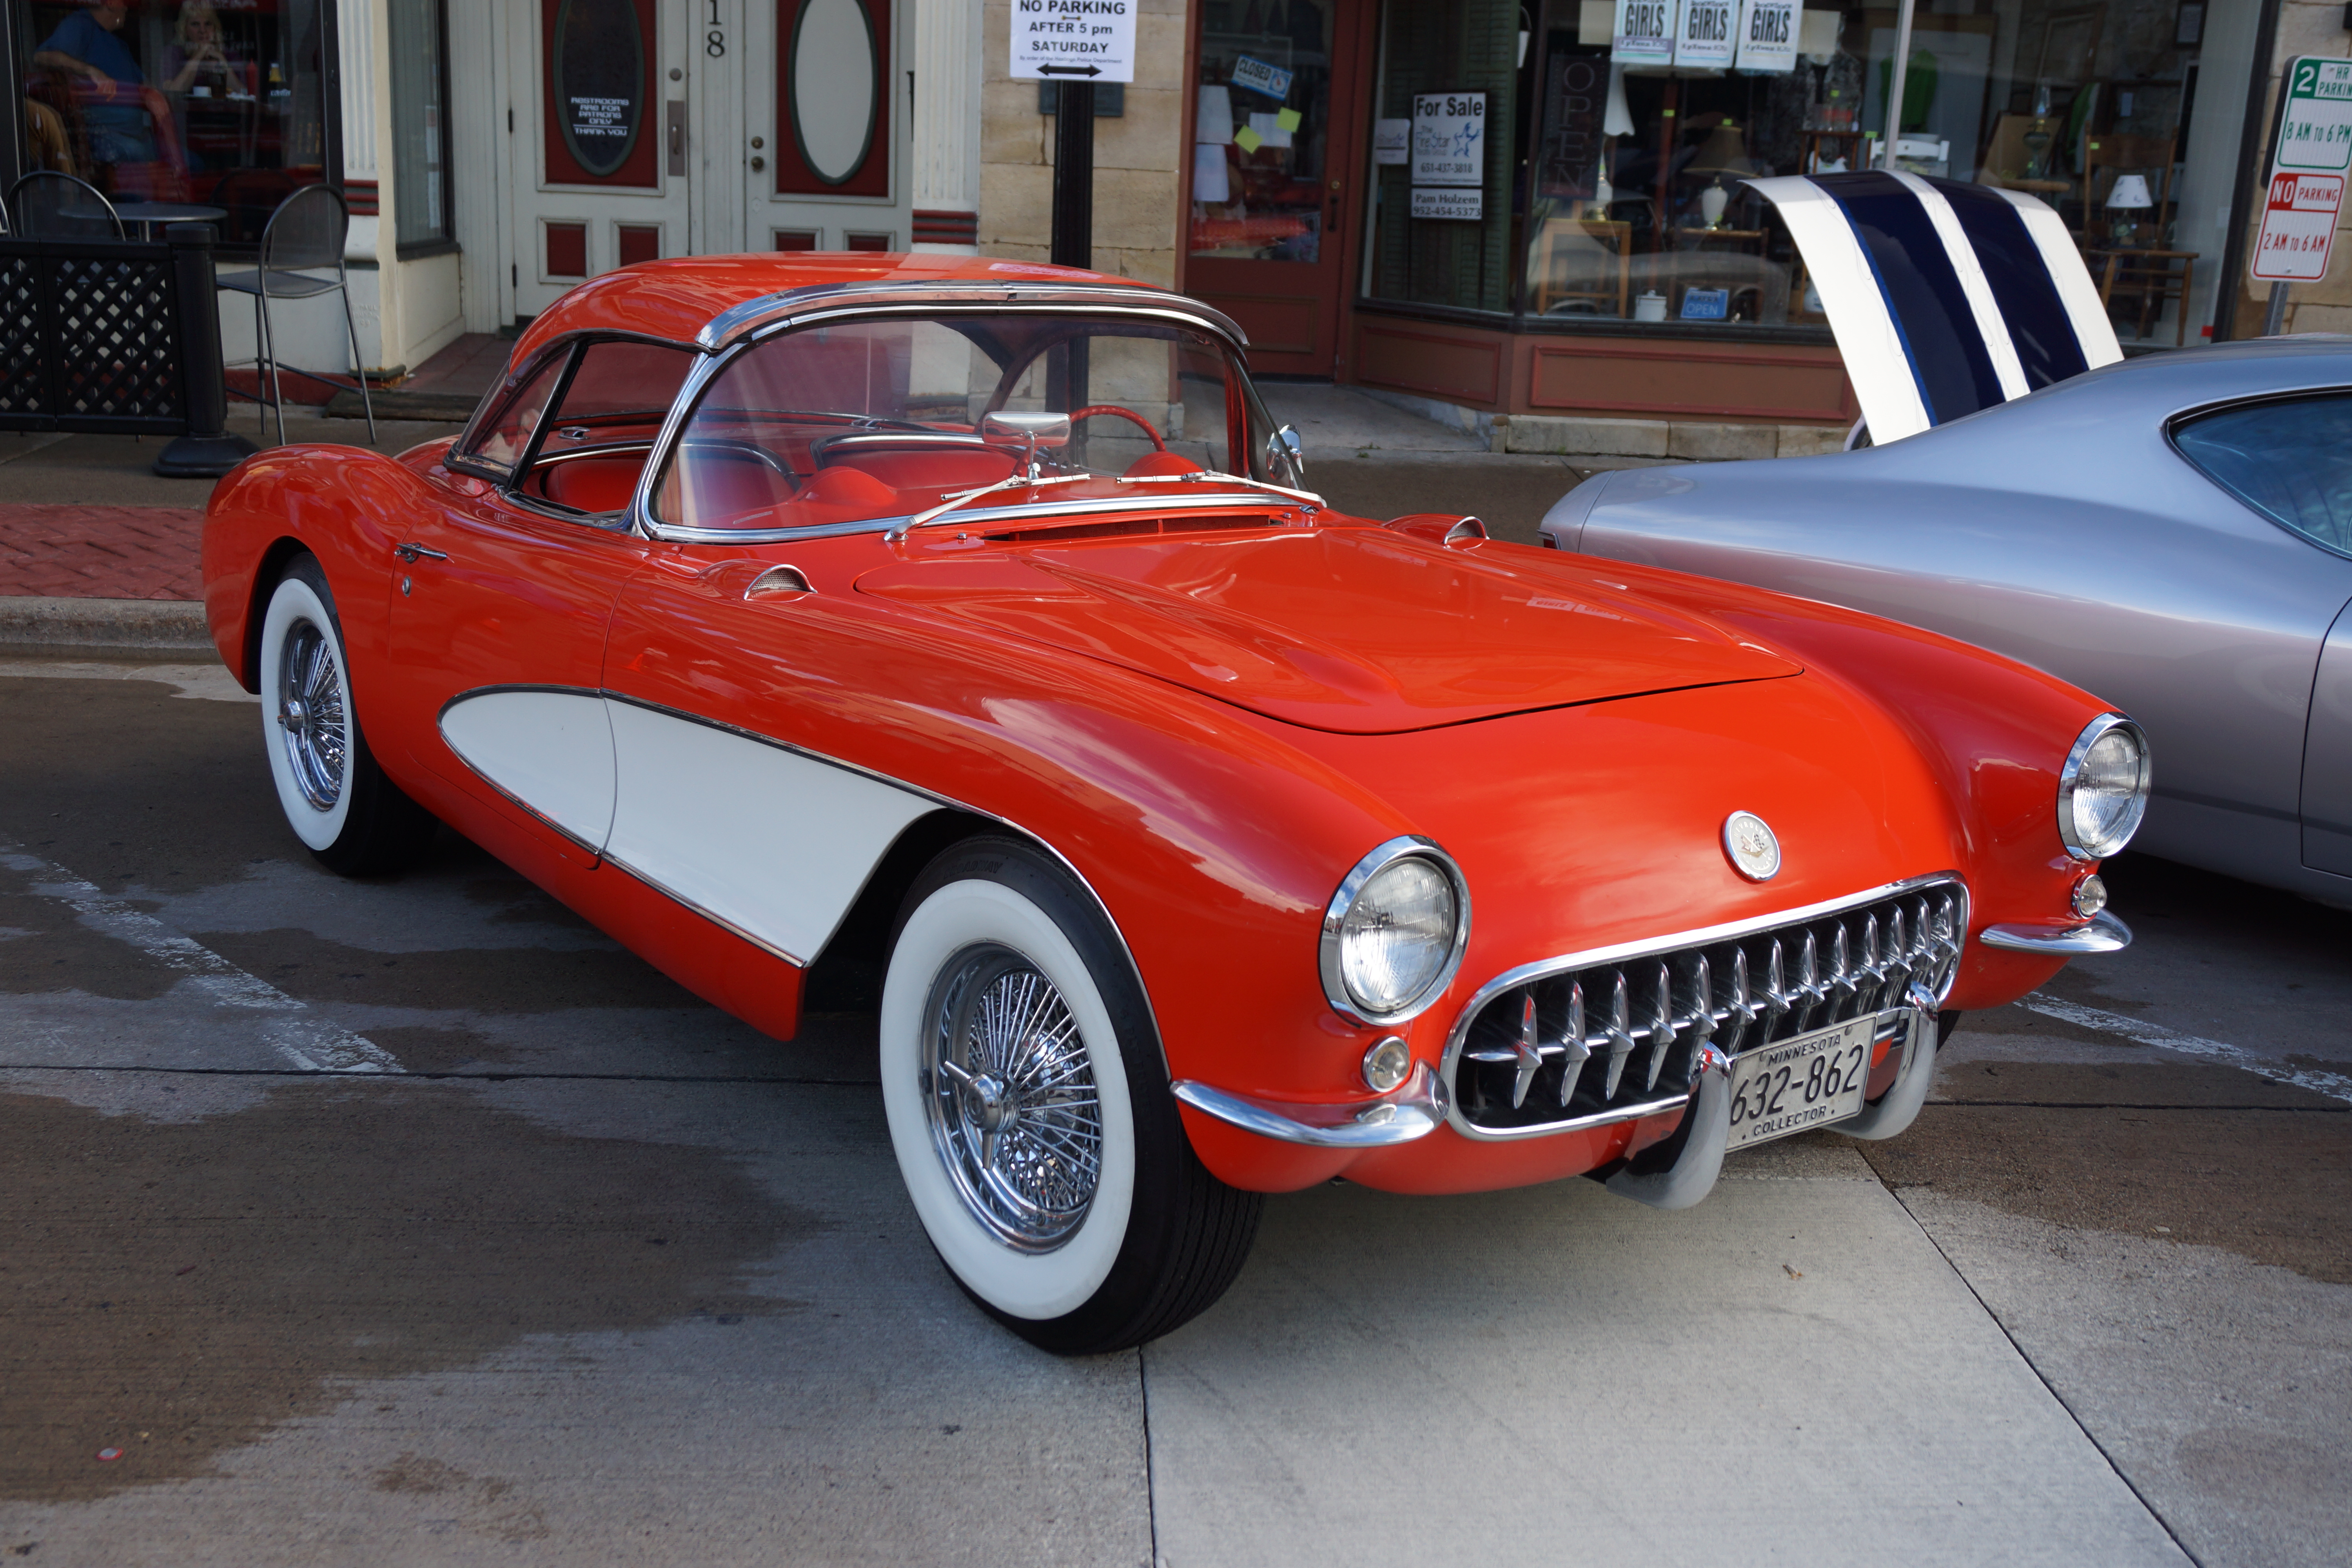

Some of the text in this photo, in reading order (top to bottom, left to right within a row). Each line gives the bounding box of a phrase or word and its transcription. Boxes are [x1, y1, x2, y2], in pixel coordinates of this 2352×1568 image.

[1020, 0, 1126, 15] NO PARKING
[1029, 22, 1112, 36] AFTER 5 pm
[1626, 3, 1664, 38] GIRLS
[1689, 7, 1728, 40] GIRLS
[1751, 8, 1790, 42] GIRLS
[1032, 40, 1109, 53] SATURDAY
[1239, 59, 1272, 81] CLOSED
[2296, 66, 2350, 92] 2 HR
[2318, 82, 2352, 96] PARKIN
[571, 97, 630, 106] RESTROOMS
[1416, 96, 1483, 116] For Sale
[579, 111, 622, 119] PATRONS
[1553, 63, 1595, 194] OPEN
[2286, 122, 2352, 143] 8 AM TO 6 PM
[1416, 194, 1479, 204] Pam Holzem
[2271, 180, 2338, 203] NO PARKING
[1414, 206, 1481, 216] 952-454-5373
[2263, 232, 2326, 252] 2 AM TO 6 AM
[1686, 303, 1718, 315] OPEN
[1768, 1034, 1841, 1065] MINNESOTA
[1730, 1044, 1864, 1126] 632-862
[1753, 1105, 1826, 1136] COLLECTOR
